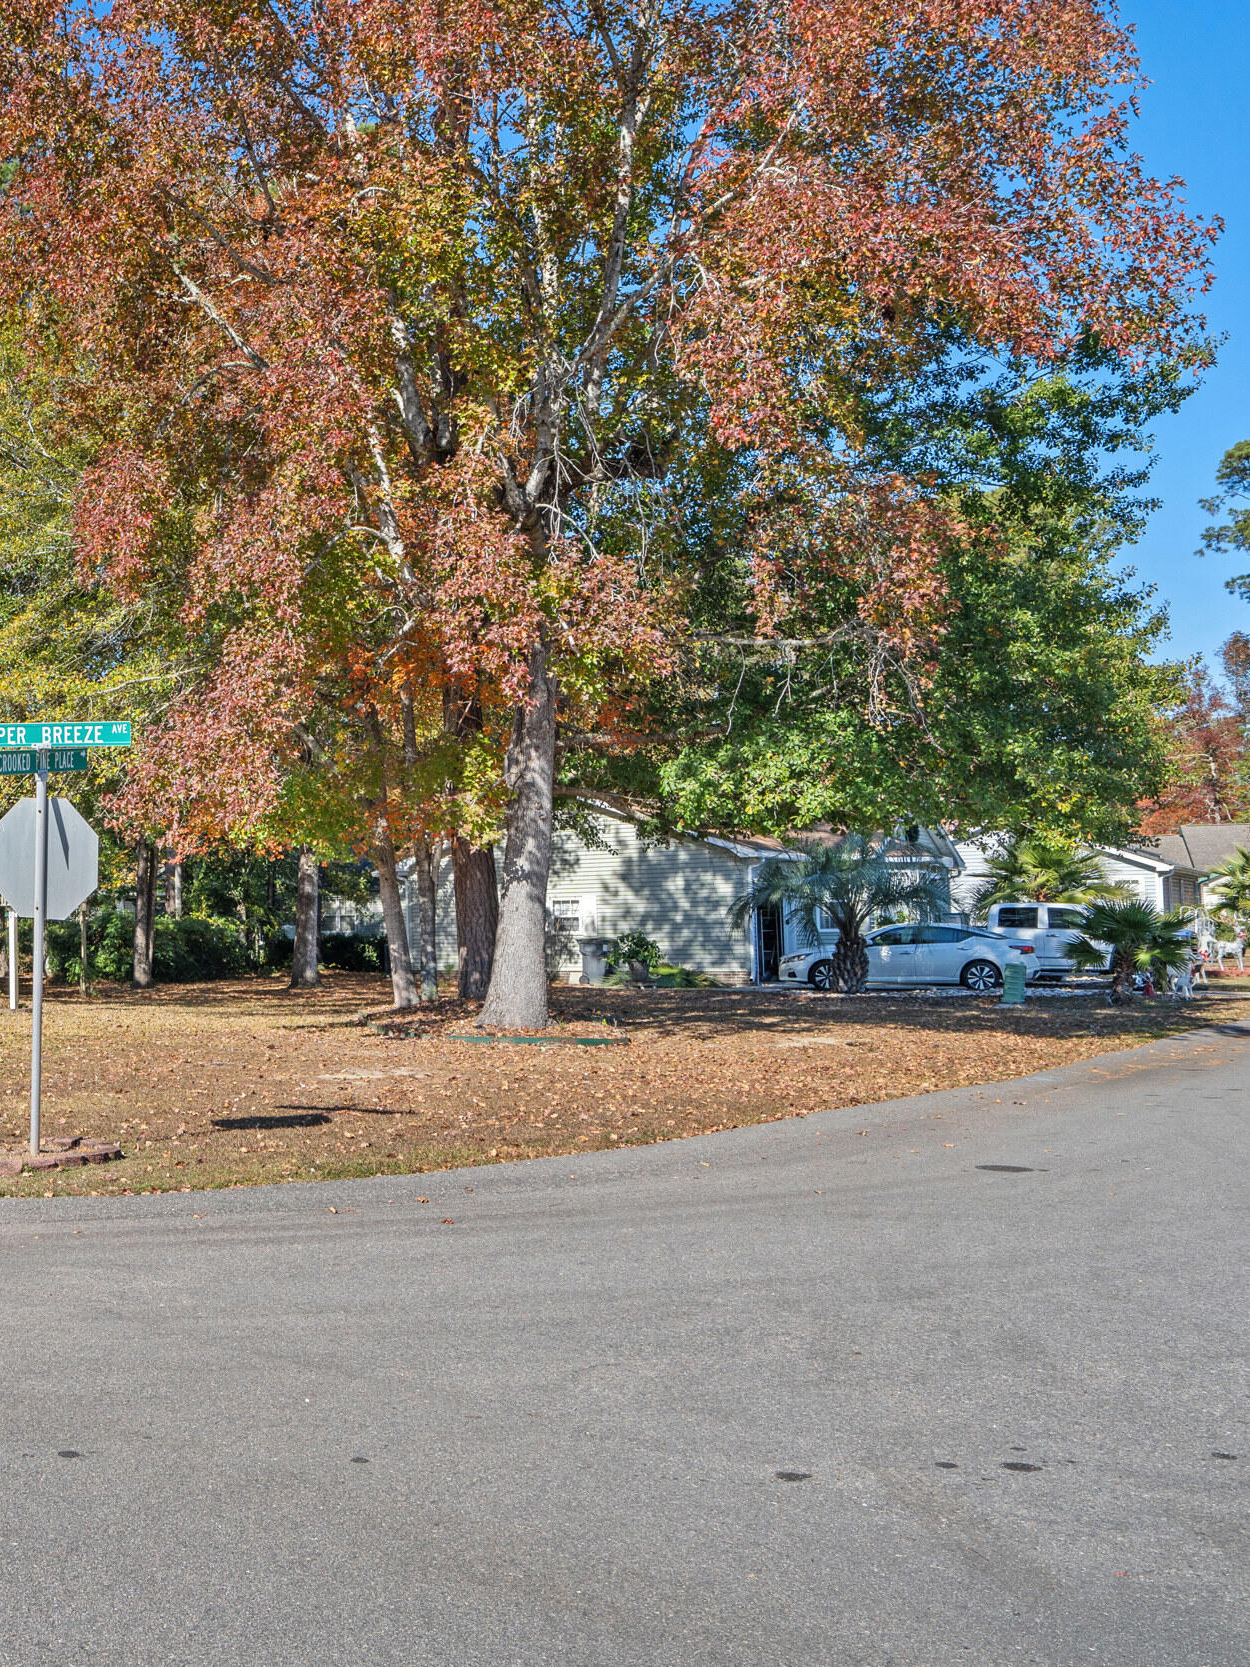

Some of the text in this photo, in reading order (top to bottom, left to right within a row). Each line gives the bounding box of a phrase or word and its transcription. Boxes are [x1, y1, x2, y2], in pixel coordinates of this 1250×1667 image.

[42, 726, 104, 744] BREEZE
[111, 724, 128, 734] AVE
[54, 750, 75, 769] PLACE
